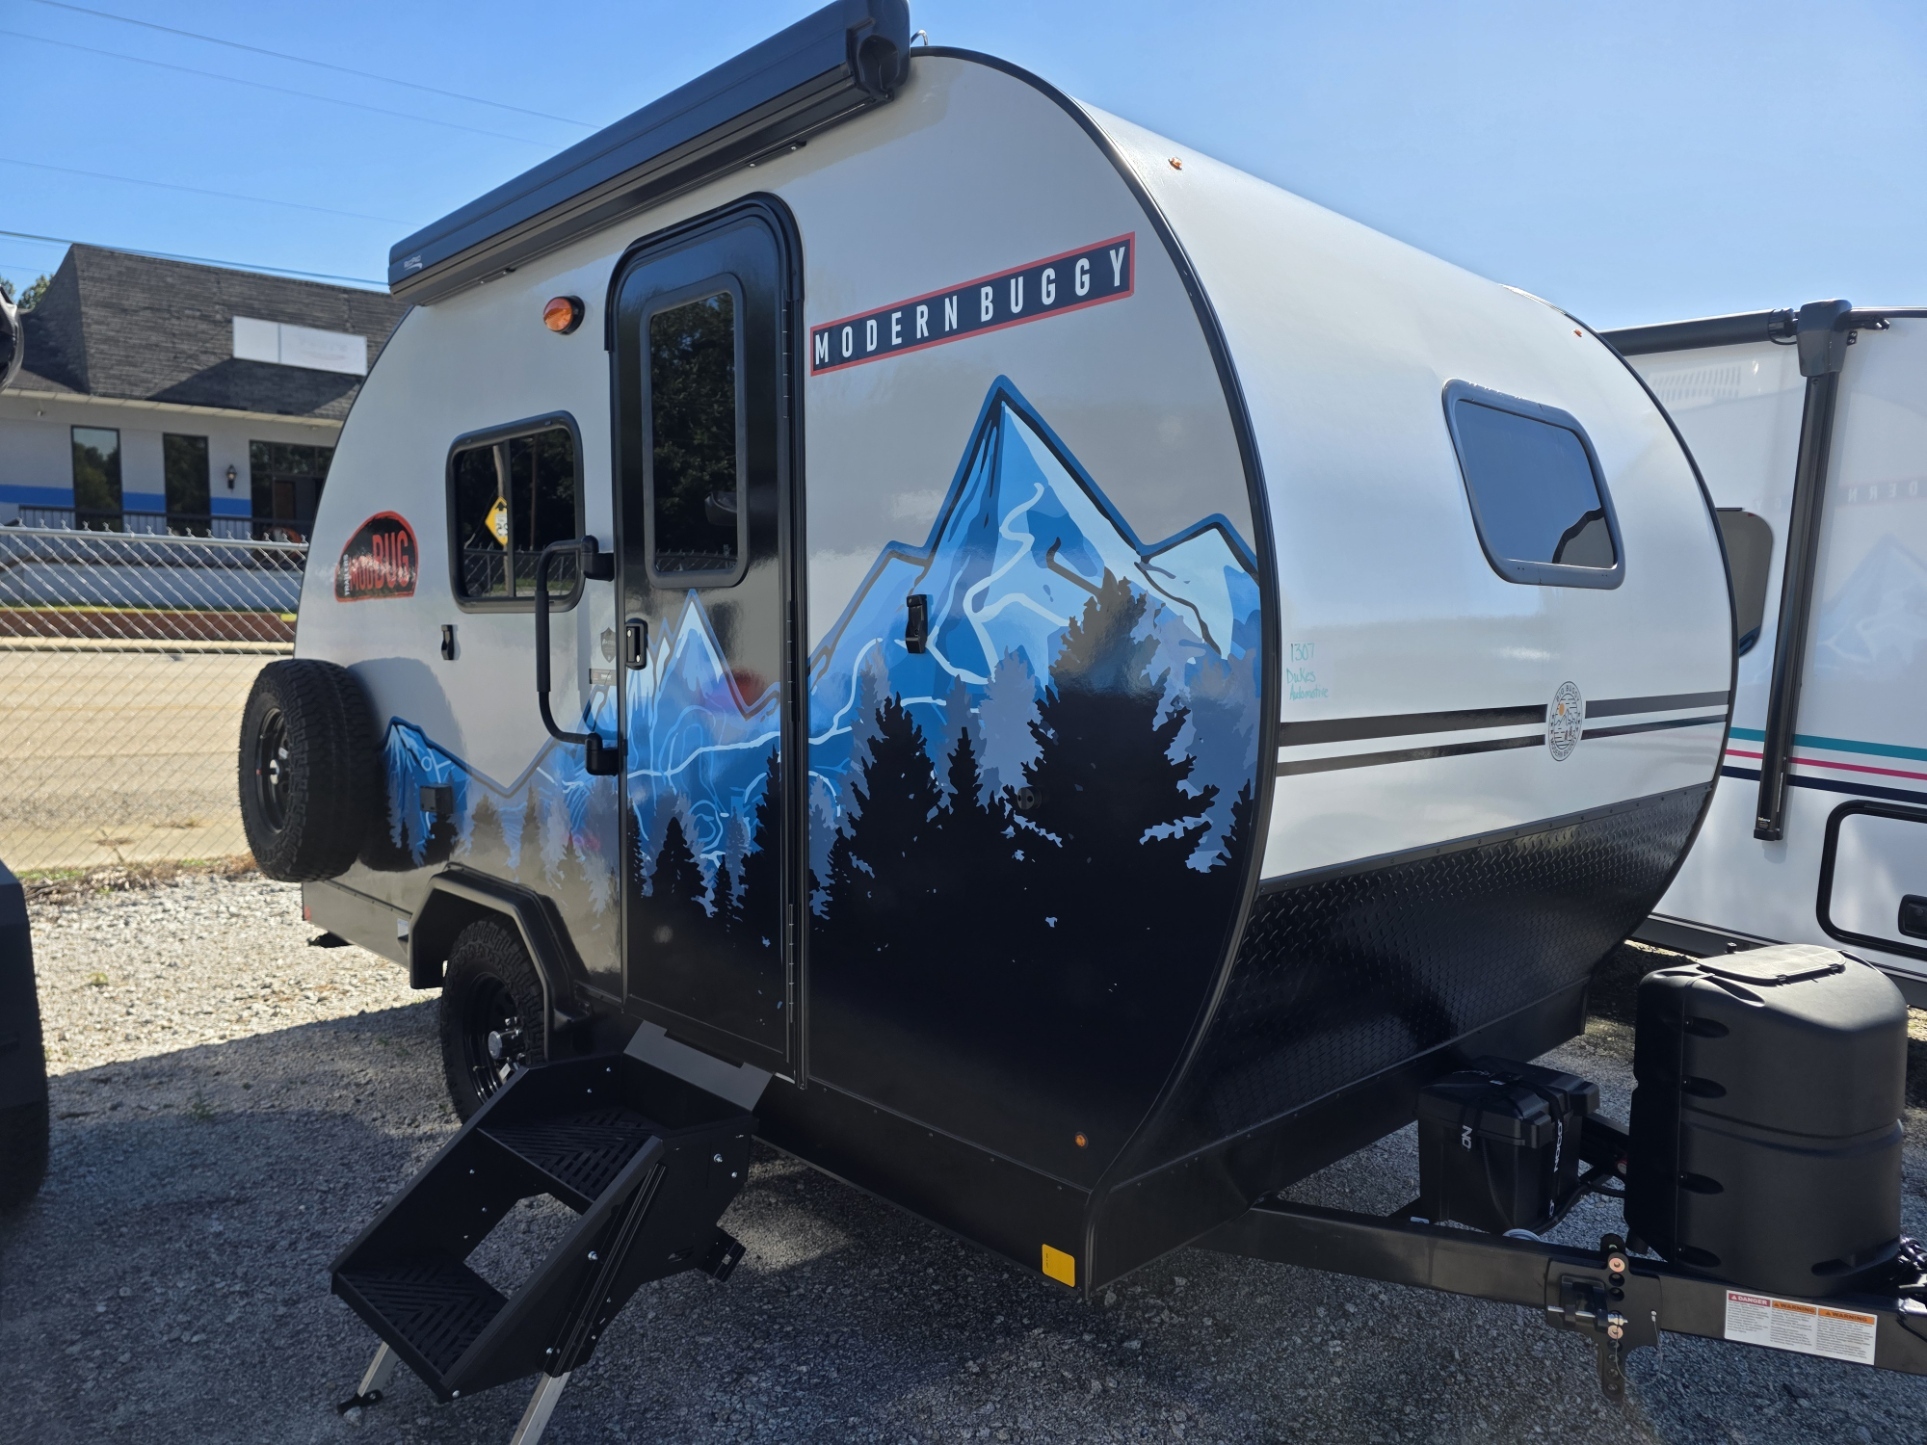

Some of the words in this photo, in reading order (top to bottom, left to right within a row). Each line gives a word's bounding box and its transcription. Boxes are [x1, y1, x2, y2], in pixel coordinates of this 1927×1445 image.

[815, 295, 958, 365] MODERN
[980, 246, 1126, 322] BUGGY
[1290, 642, 1315, 662] 1307
[1738, 1296, 1768, 1305] DANGER
[1780, 1303, 1815, 1314] WARNING
[1832, 1312, 1868, 1322] WARNING
